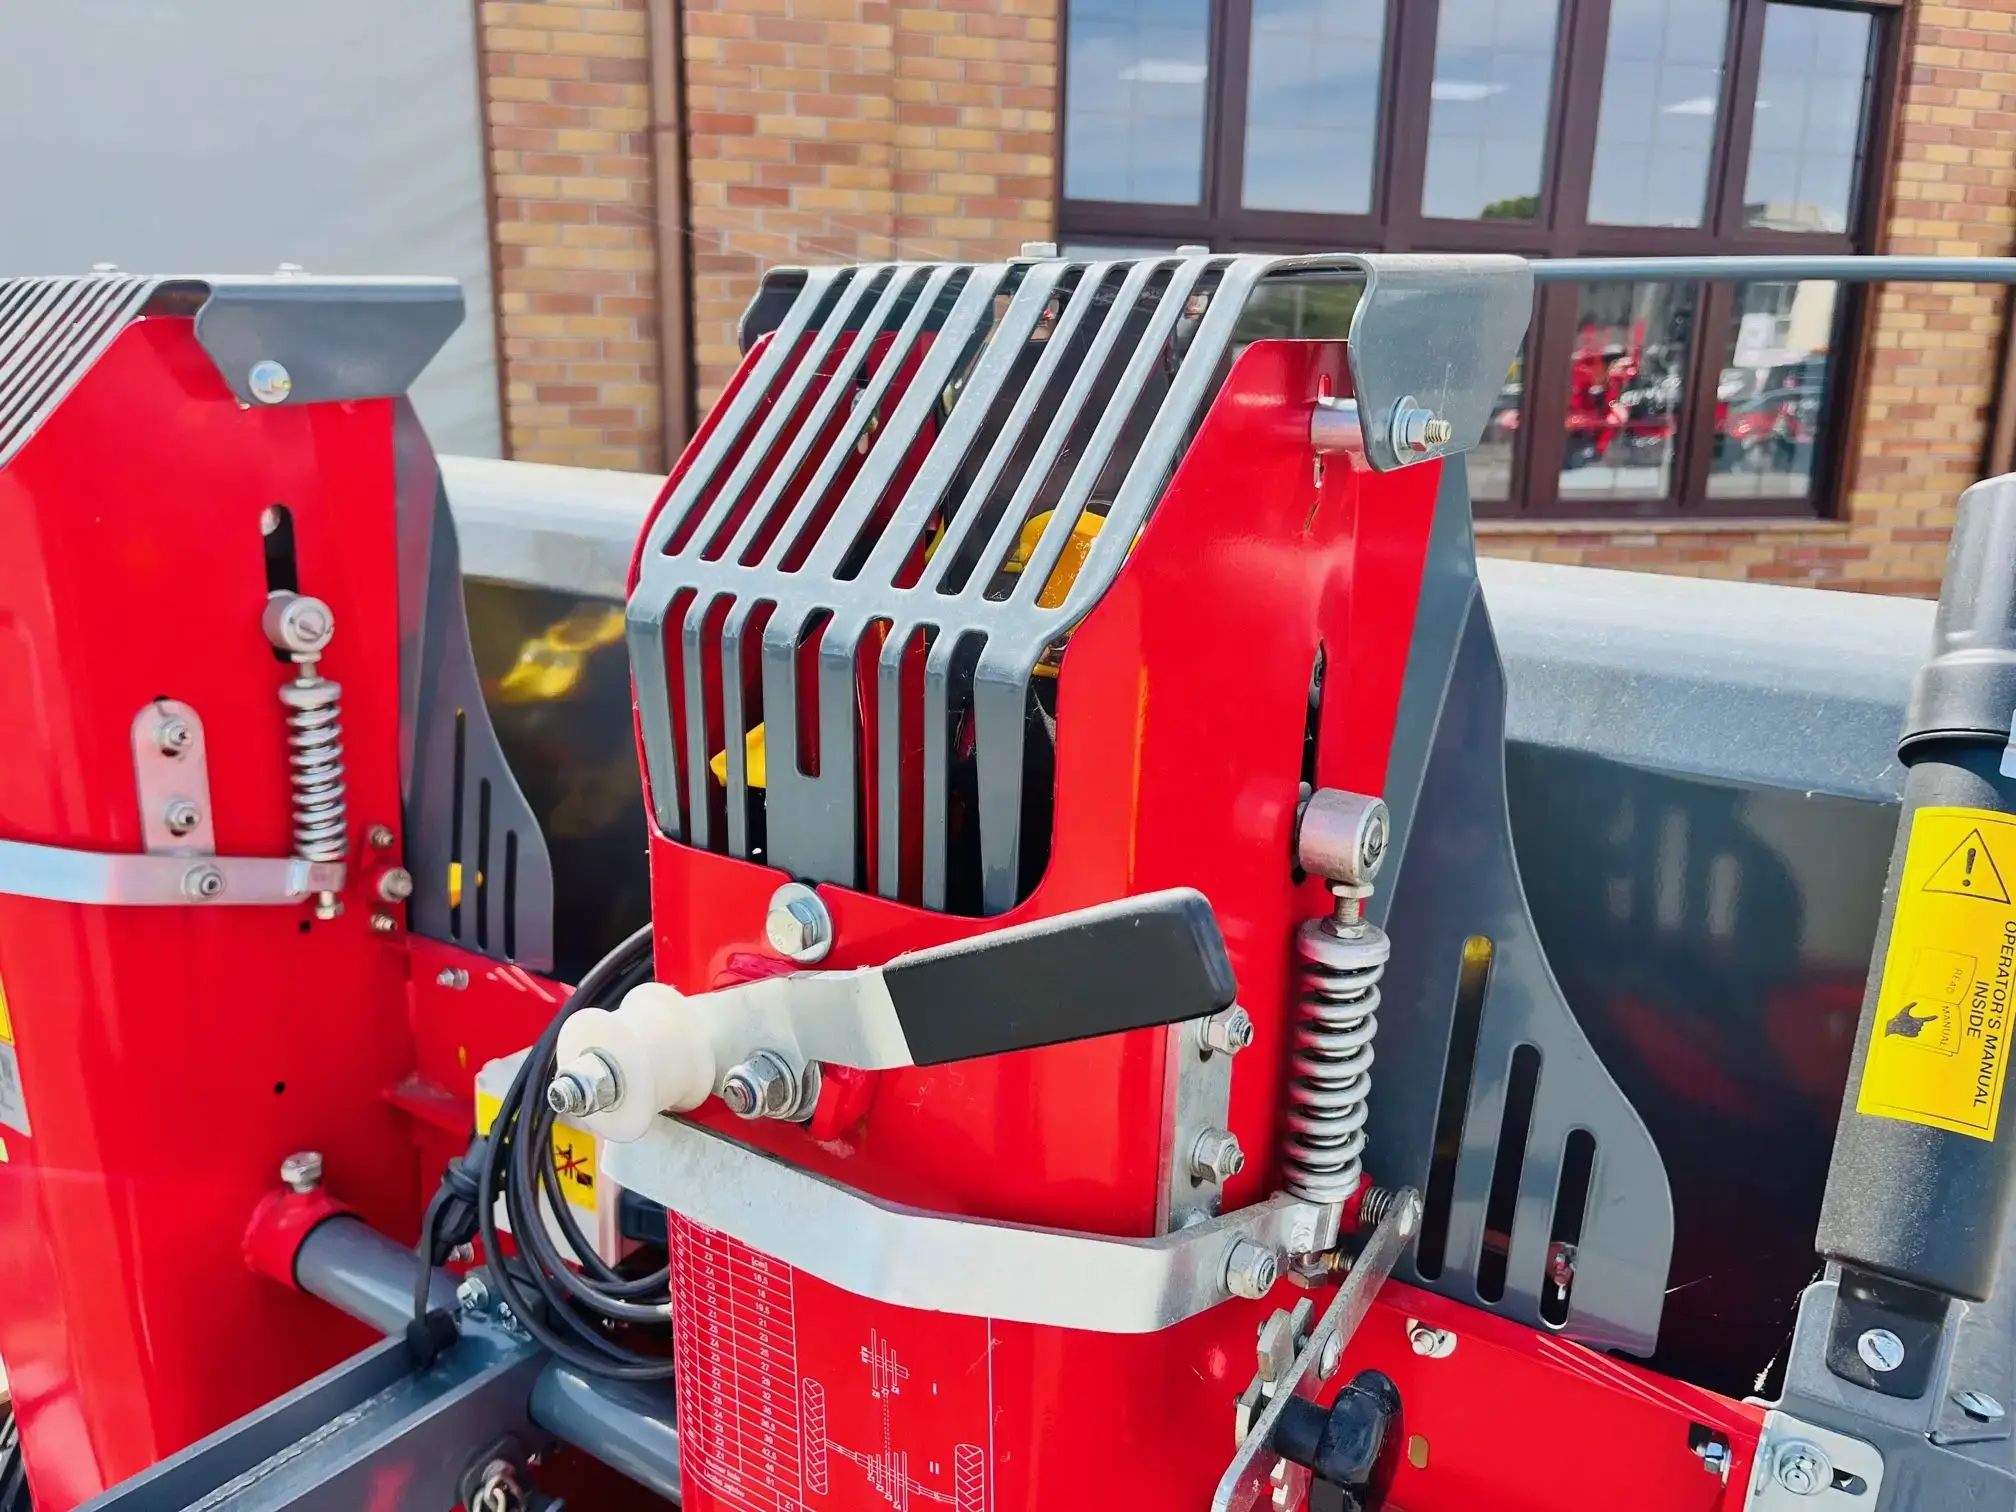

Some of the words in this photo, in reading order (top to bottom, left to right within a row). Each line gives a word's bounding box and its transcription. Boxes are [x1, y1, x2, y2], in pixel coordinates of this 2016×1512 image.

[1946, 968, 1962, 994] READ
[1987, 921, 2016, 1030] OPERATOR'S
[1967, 981, 1989, 1038] INSIDE
[1940, 1005, 1952, 1047] MANUAL
[1973, 1035, 1998, 1107] MANUAL
[706, 1266, 714, 1276] Z4
[757, 1289, 766, 1298] 18
[708, 1310, 716, 1319] Z1
[760, 1333, 768, 1342] 23
[759, 1318, 767, 1327] 21
[712, 1380, 720, 1390] Z1
[785, 1500, 794, 1511] Z1
